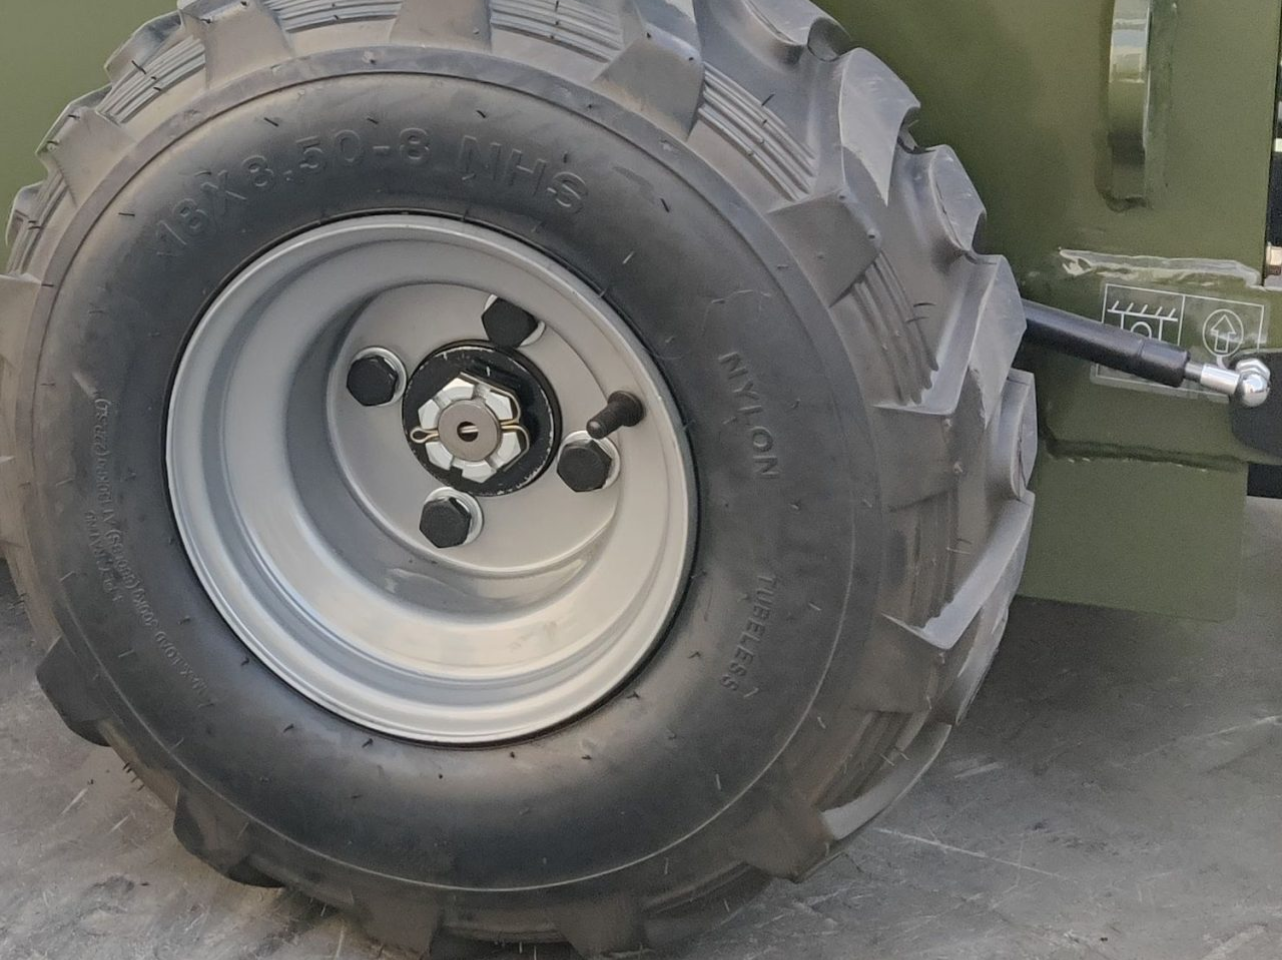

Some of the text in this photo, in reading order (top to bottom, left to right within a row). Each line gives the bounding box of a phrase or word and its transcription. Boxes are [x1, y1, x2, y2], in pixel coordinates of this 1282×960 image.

[459, 134, 590, 216] NHS
[717, 350, 781, 480] NYLON
[720, 572, 779, 693] TUBELESS
